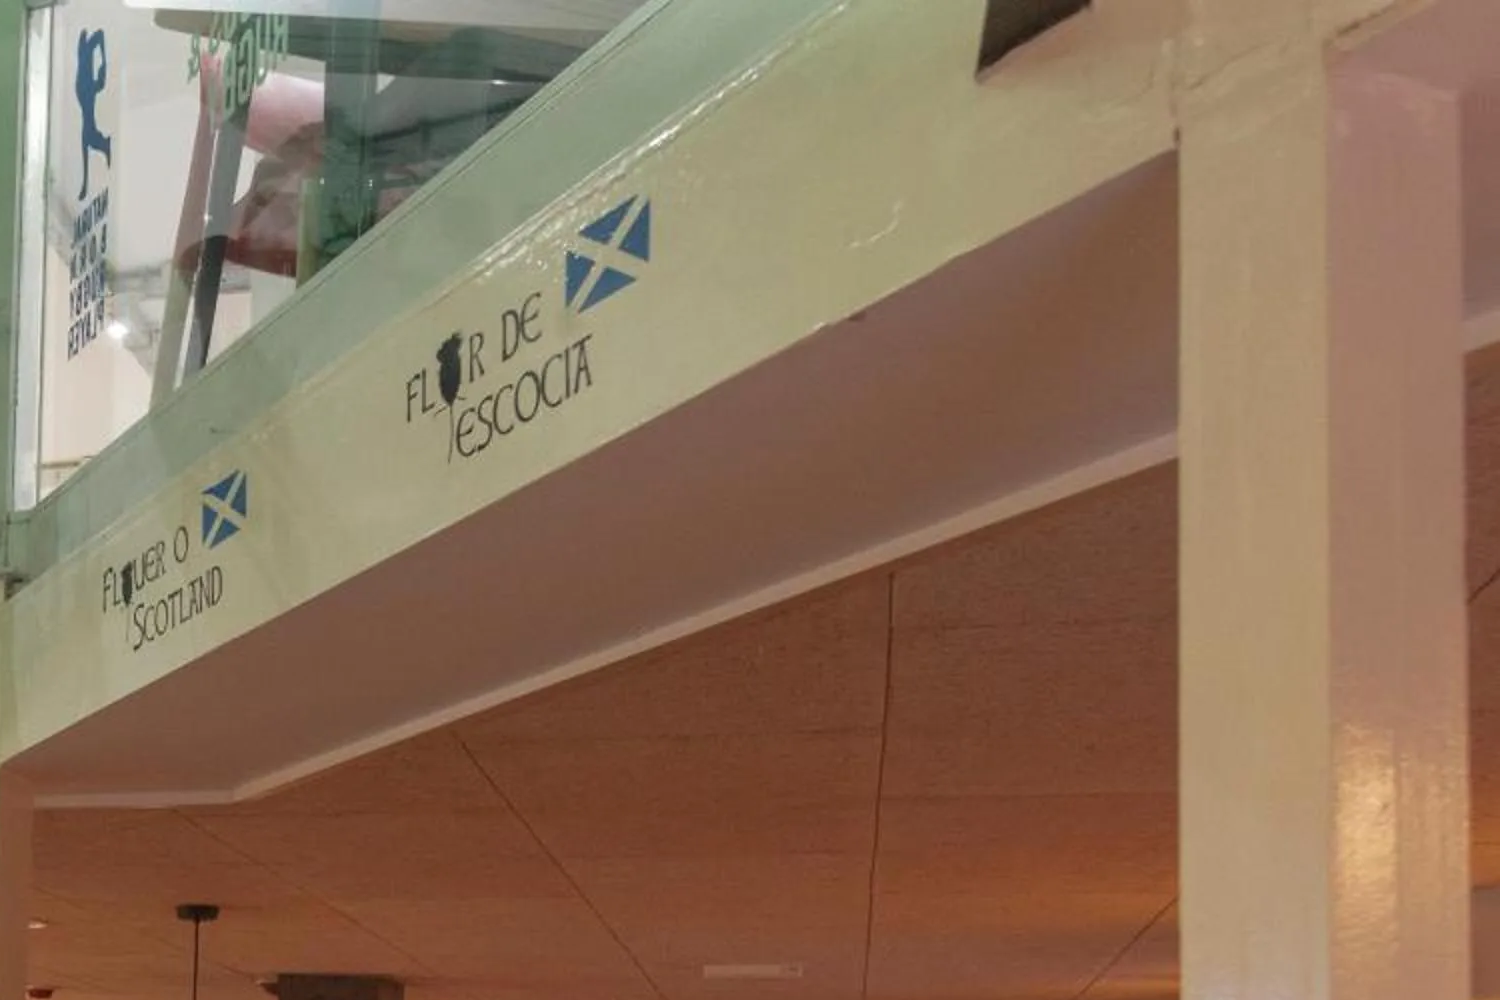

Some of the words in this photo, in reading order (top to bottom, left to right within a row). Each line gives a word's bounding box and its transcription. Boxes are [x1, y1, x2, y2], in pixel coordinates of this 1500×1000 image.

[406, 328, 485, 423] FLR
[501, 290, 542, 362] DE
[455, 334, 593, 457] ESCOCIA
[174, 525, 189, 564] O
[133, 566, 223, 652] SCOTLAND
